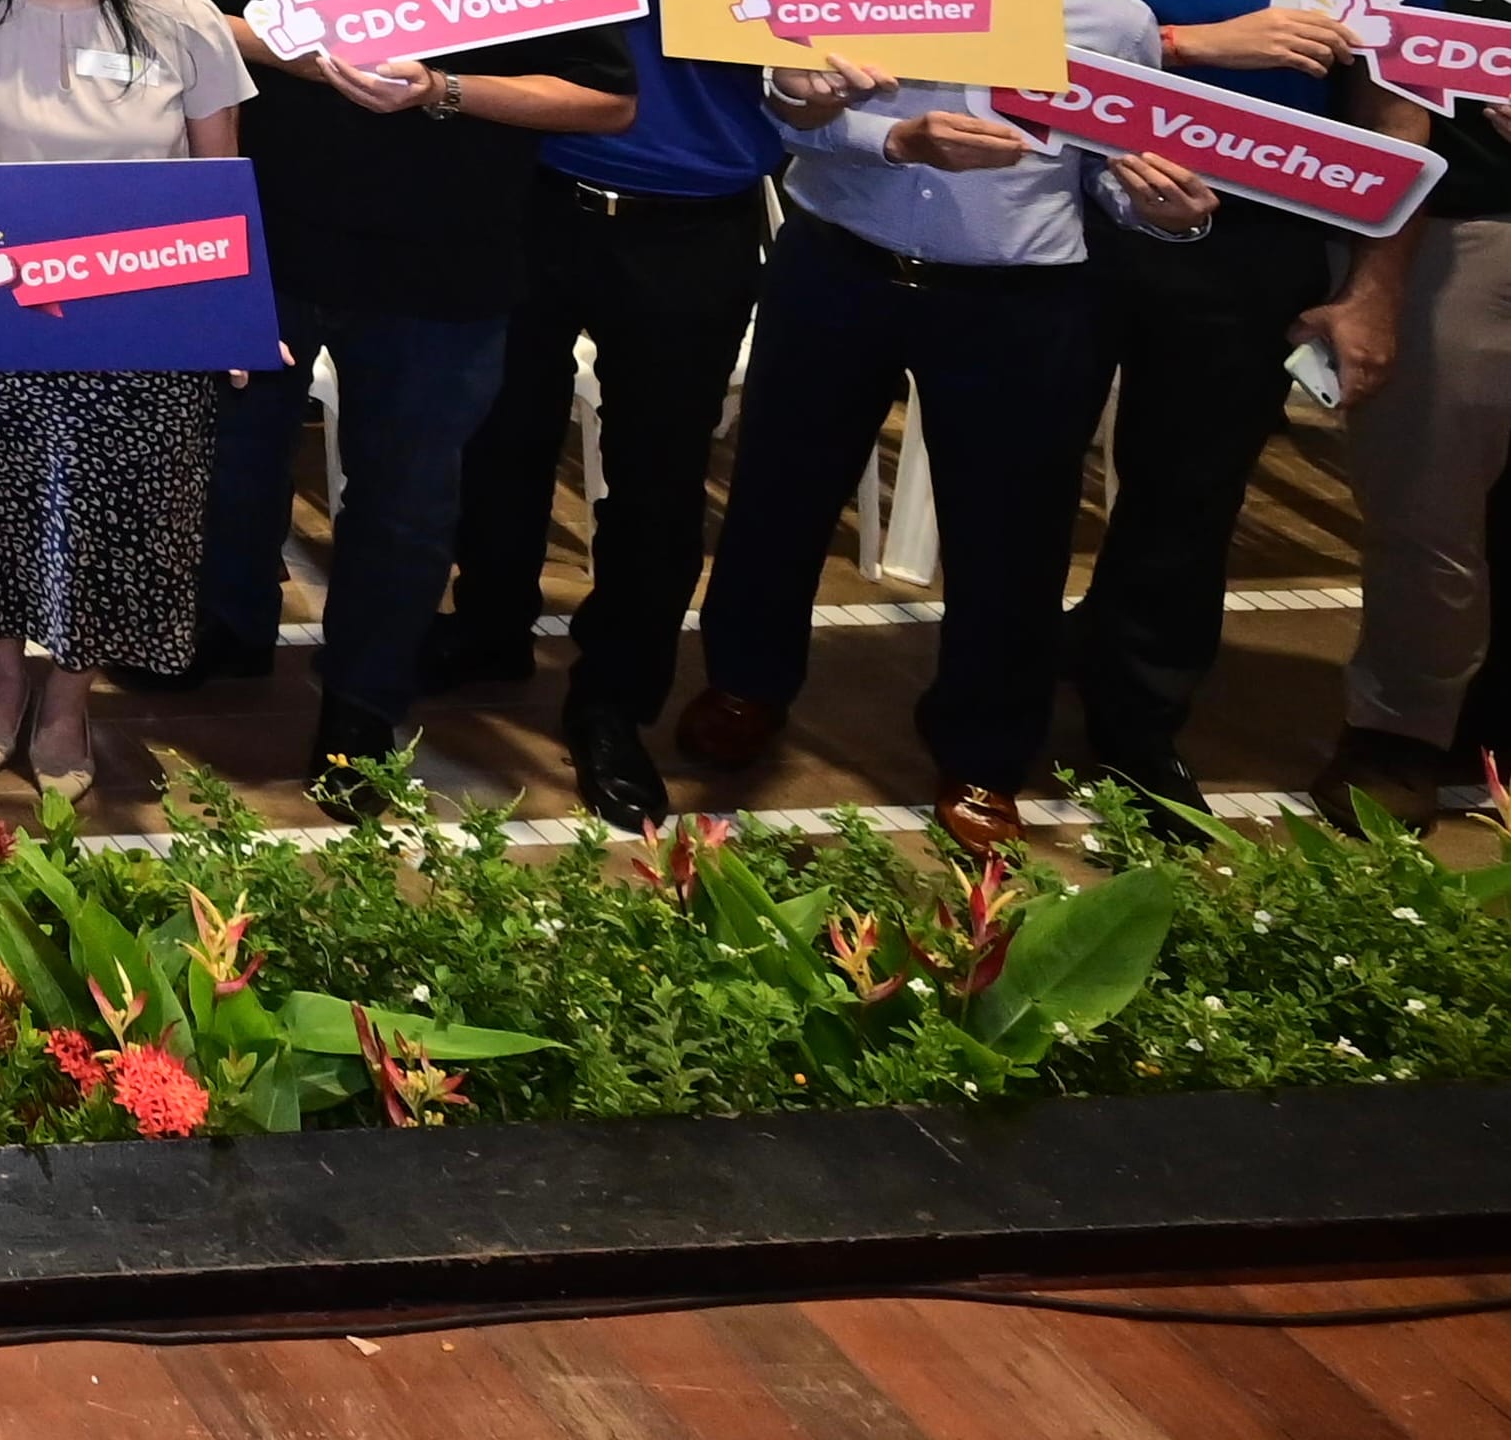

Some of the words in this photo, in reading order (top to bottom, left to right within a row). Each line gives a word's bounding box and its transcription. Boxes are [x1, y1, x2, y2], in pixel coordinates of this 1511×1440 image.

[335, 2, 426, 44] CDC
[778, 2, 841, 24] CDC
[849, 0, 975, 21] Voucher
[1400, 35, 1511, 77] CDC
[1150, 106, 1385, 197] Voucher
[21, 255, 89, 287] CDC
[96, 238, 229, 276] Voucher
